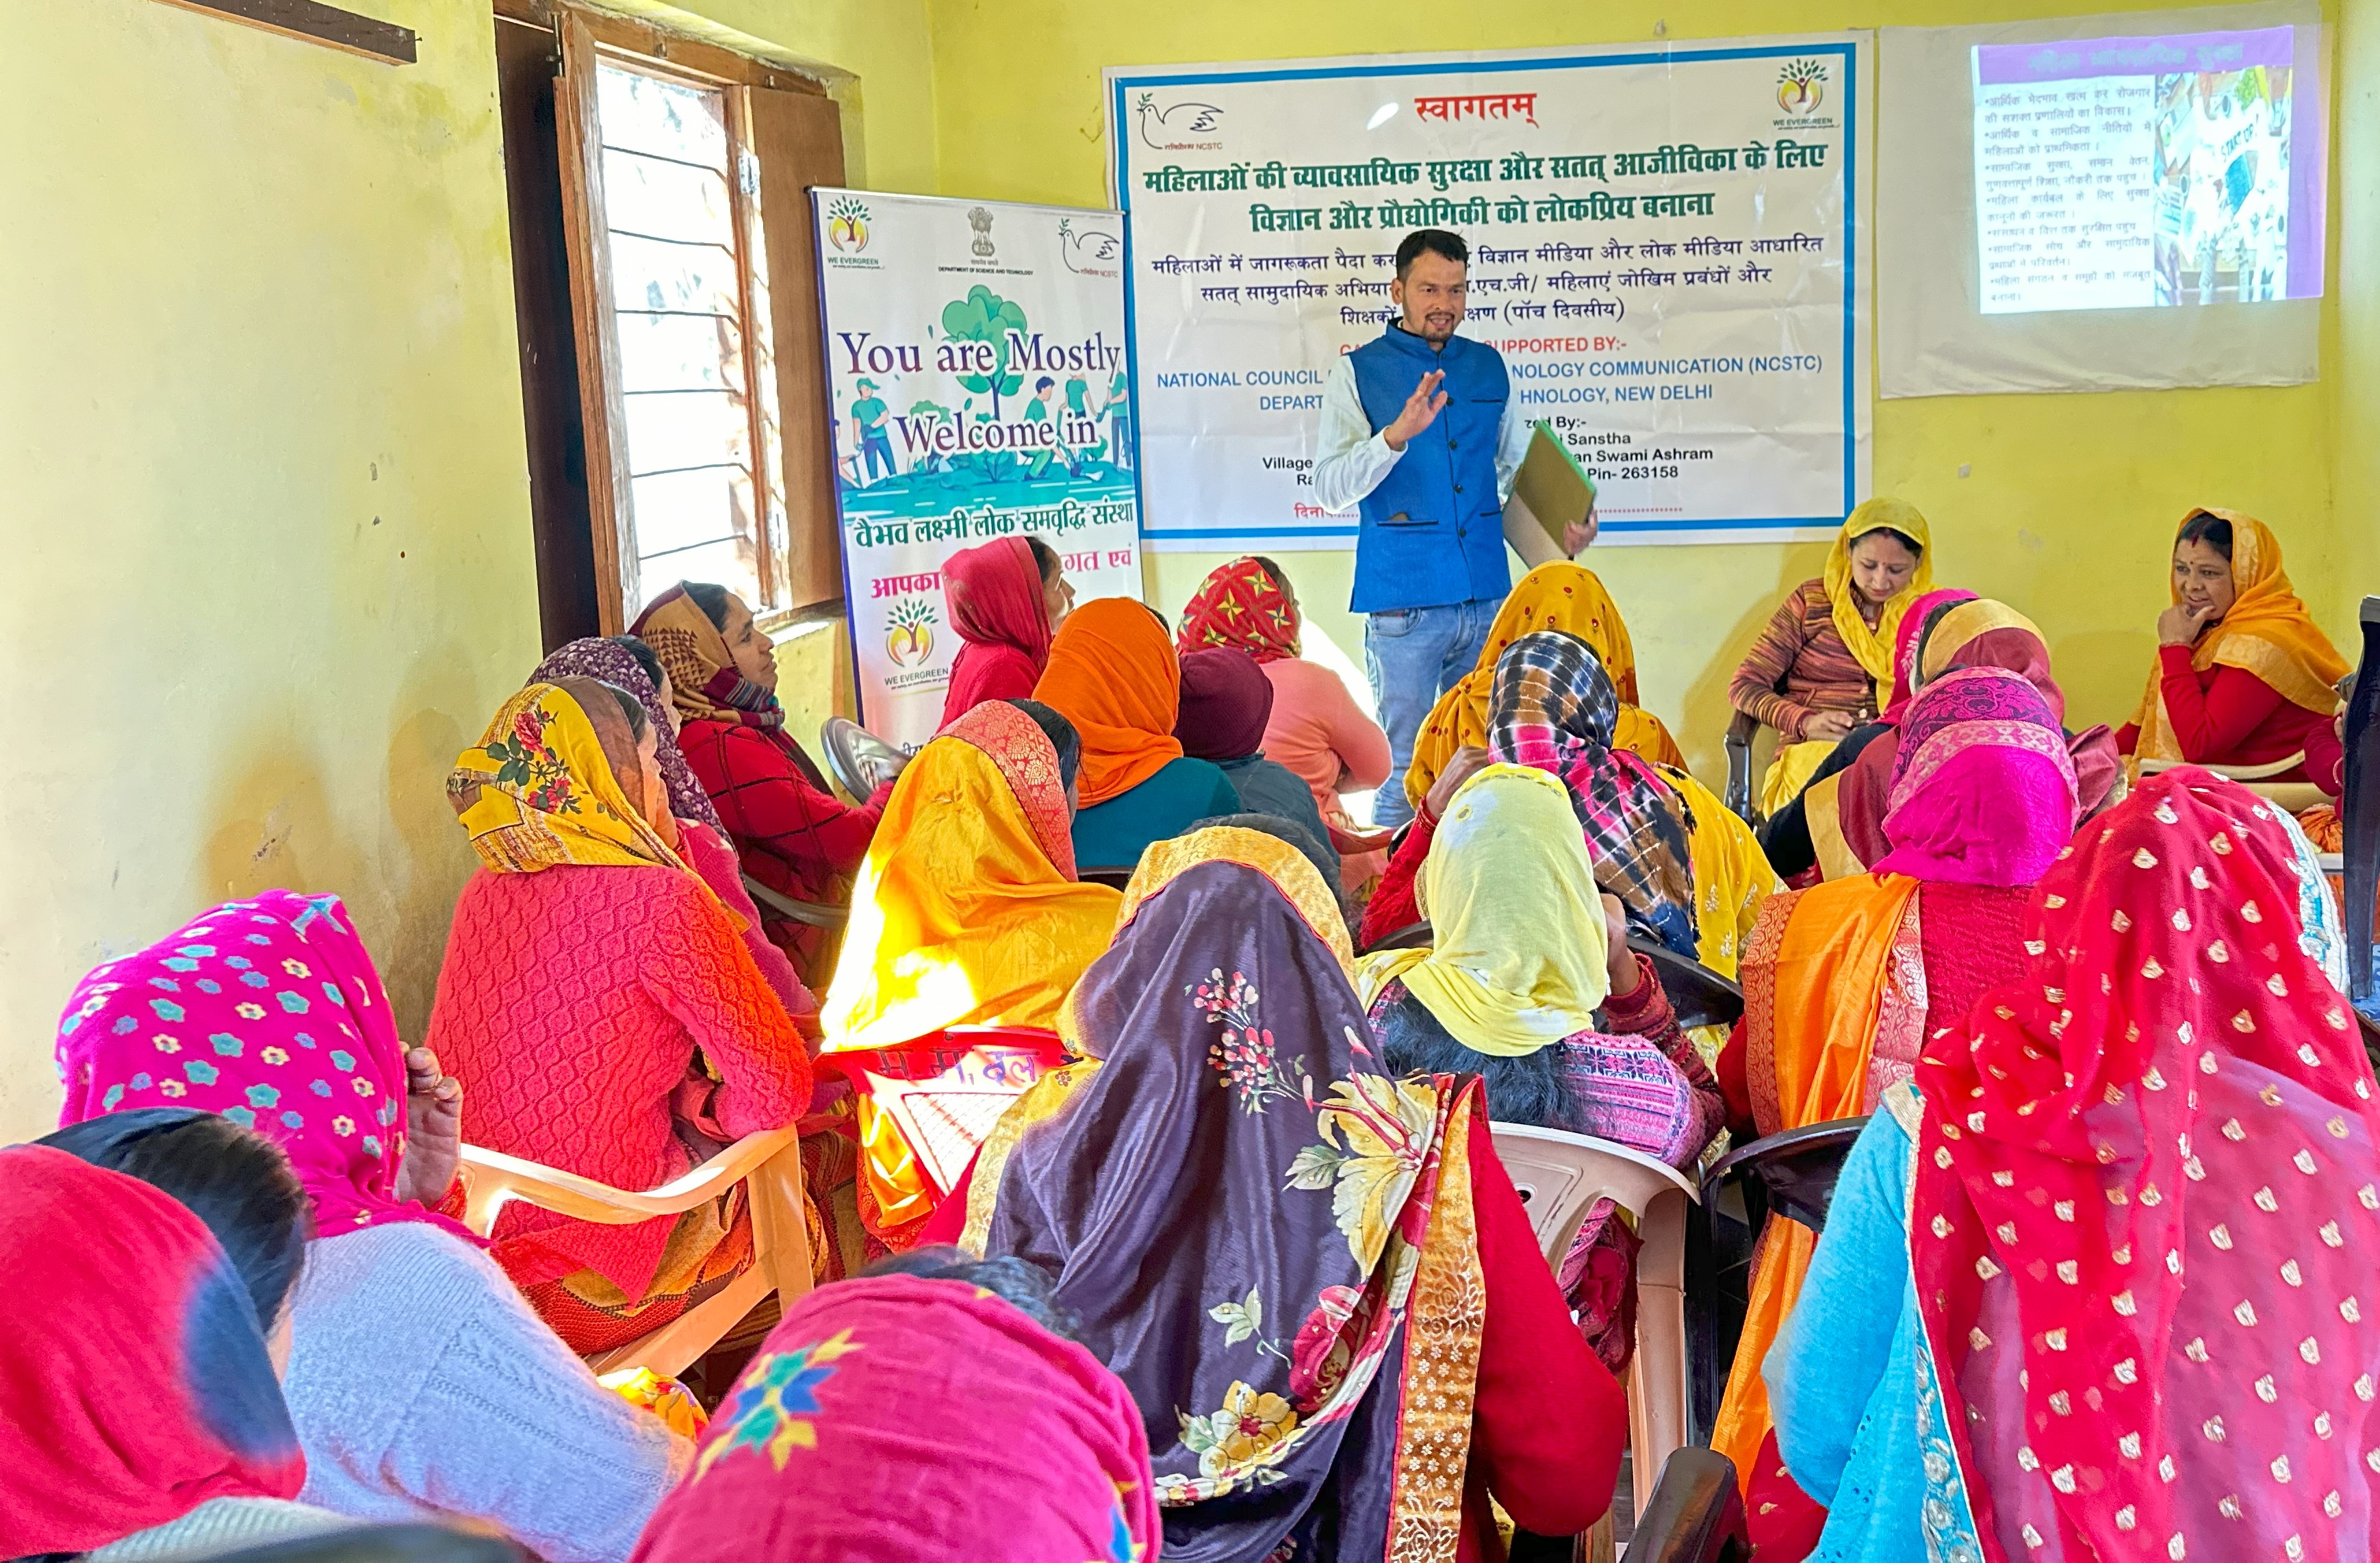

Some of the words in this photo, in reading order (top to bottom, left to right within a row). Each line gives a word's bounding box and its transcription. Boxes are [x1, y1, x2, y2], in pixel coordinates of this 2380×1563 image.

[2094, 89, 2108, 99] कर
[2116, 86, 2151, 98] रोजगार
[1414, 93, 1539, 128] स्वागतम्
[2078, 108, 2090, 118] का
[2050, 124, 2090, 136] सामाजिक
[1143, 162, 1251, 192] महिलाओं
[1253, 161, 1288, 189] की
[1290, 157, 1421, 187] व्यावसायिक
[1426, 160, 1492, 192] सुरक्षा
[1500, 151, 1544, 181] और
[1549, 155, 1609, 183] सतत्
[1614, 144, 1737, 175] आजीविका
[1742, 140, 1769, 169] के
[1774, 139, 1828, 169] लिए
[1991, 161, 2031, 173] सामाजिक
[1249, 204, 1322, 232] विज्ञान
[1329, 201, 1373, 229] और
[1378, 196, 1491, 229] प्रौद्योगिकी
[1495, 195, 1529, 223] को
[1534, 192, 1637, 222] लोकप्रिय
[1641, 193, 1715, 218] बनाना
[840, 257, 878, 265] EVERGREEN
[1152, 254, 1223, 275] महिलाओं
[1229, 254, 1243, 272] में
[1249, 255, 1329, 270] जागरूकता
[1335, 247, 1365, 268] पैदा
[1479, 245, 1529, 264] विज्ञान
[1536, 242, 1593, 262] मीडिया
[1601, 238, 1634, 259] और
[1639, 240, 1676, 258] लोक
[1683, 236, 1743, 256] मीडिया
[1750, 232, 1824, 253] आधारित
[1201, 287, 1240, 305] सतत्
[1246, 279, 1328, 305] सामुदायिक
[1335, 278, 1392, 297] अभिया
[1547, 270, 1611, 292] महिलाएं
[1617, 268, 1676, 289] जोखिम
[1683, 265, 1730, 285] प्रबंधों
[1738, 261, 1772, 283] और
[1340, 305, 1396, 325] शिक्षकों
[1553, 296, 1624, 322] दिवसीय)
[837, 332, 923, 374] You
[937, 341, 996, 372] are
[1008, 331, 1121, 383] Mostly
[1157, 371, 1241, 387] NATIONAL
[1246, 370, 1323, 385] COUNCIL
[1512, 362, 1585, 379] NOLOGY
[1589, 357, 1743, 377] COMMUNICATION
[1749, 355, 1822, 375] (NCSTC)
[1260, 395, 1323, 411] DEPART
[1520, 387, 1609, 405] HNOLOGY,
[1615, 385, 1655, 402] NEW
[1660, 384, 1712, 401] DELHI
[893, 411, 1055, 453] Welcome
[1067, 412, 1098, 444] in
[1568, 432, 1631, 446] Sanstha
[1263, 457, 1313, 471] Village
[1596, 448, 1648, 462] Swami
[1652, 447, 1713, 461] Ashram
[1622, 466, 1678, 479] 263158
[854, 518, 908, 547] वैभव
[914, 510, 967, 542] लक्ष्मी
[973, 507, 1015, 536] लोक
[1091, 498, 1133, 524] संस्था
[871, 572, 941, 598] आपका
[1108, 542, 1131, 568] एवं
[885, 676, 898, 685] WE
[900, 668, 948, 683] EVERGREEN
